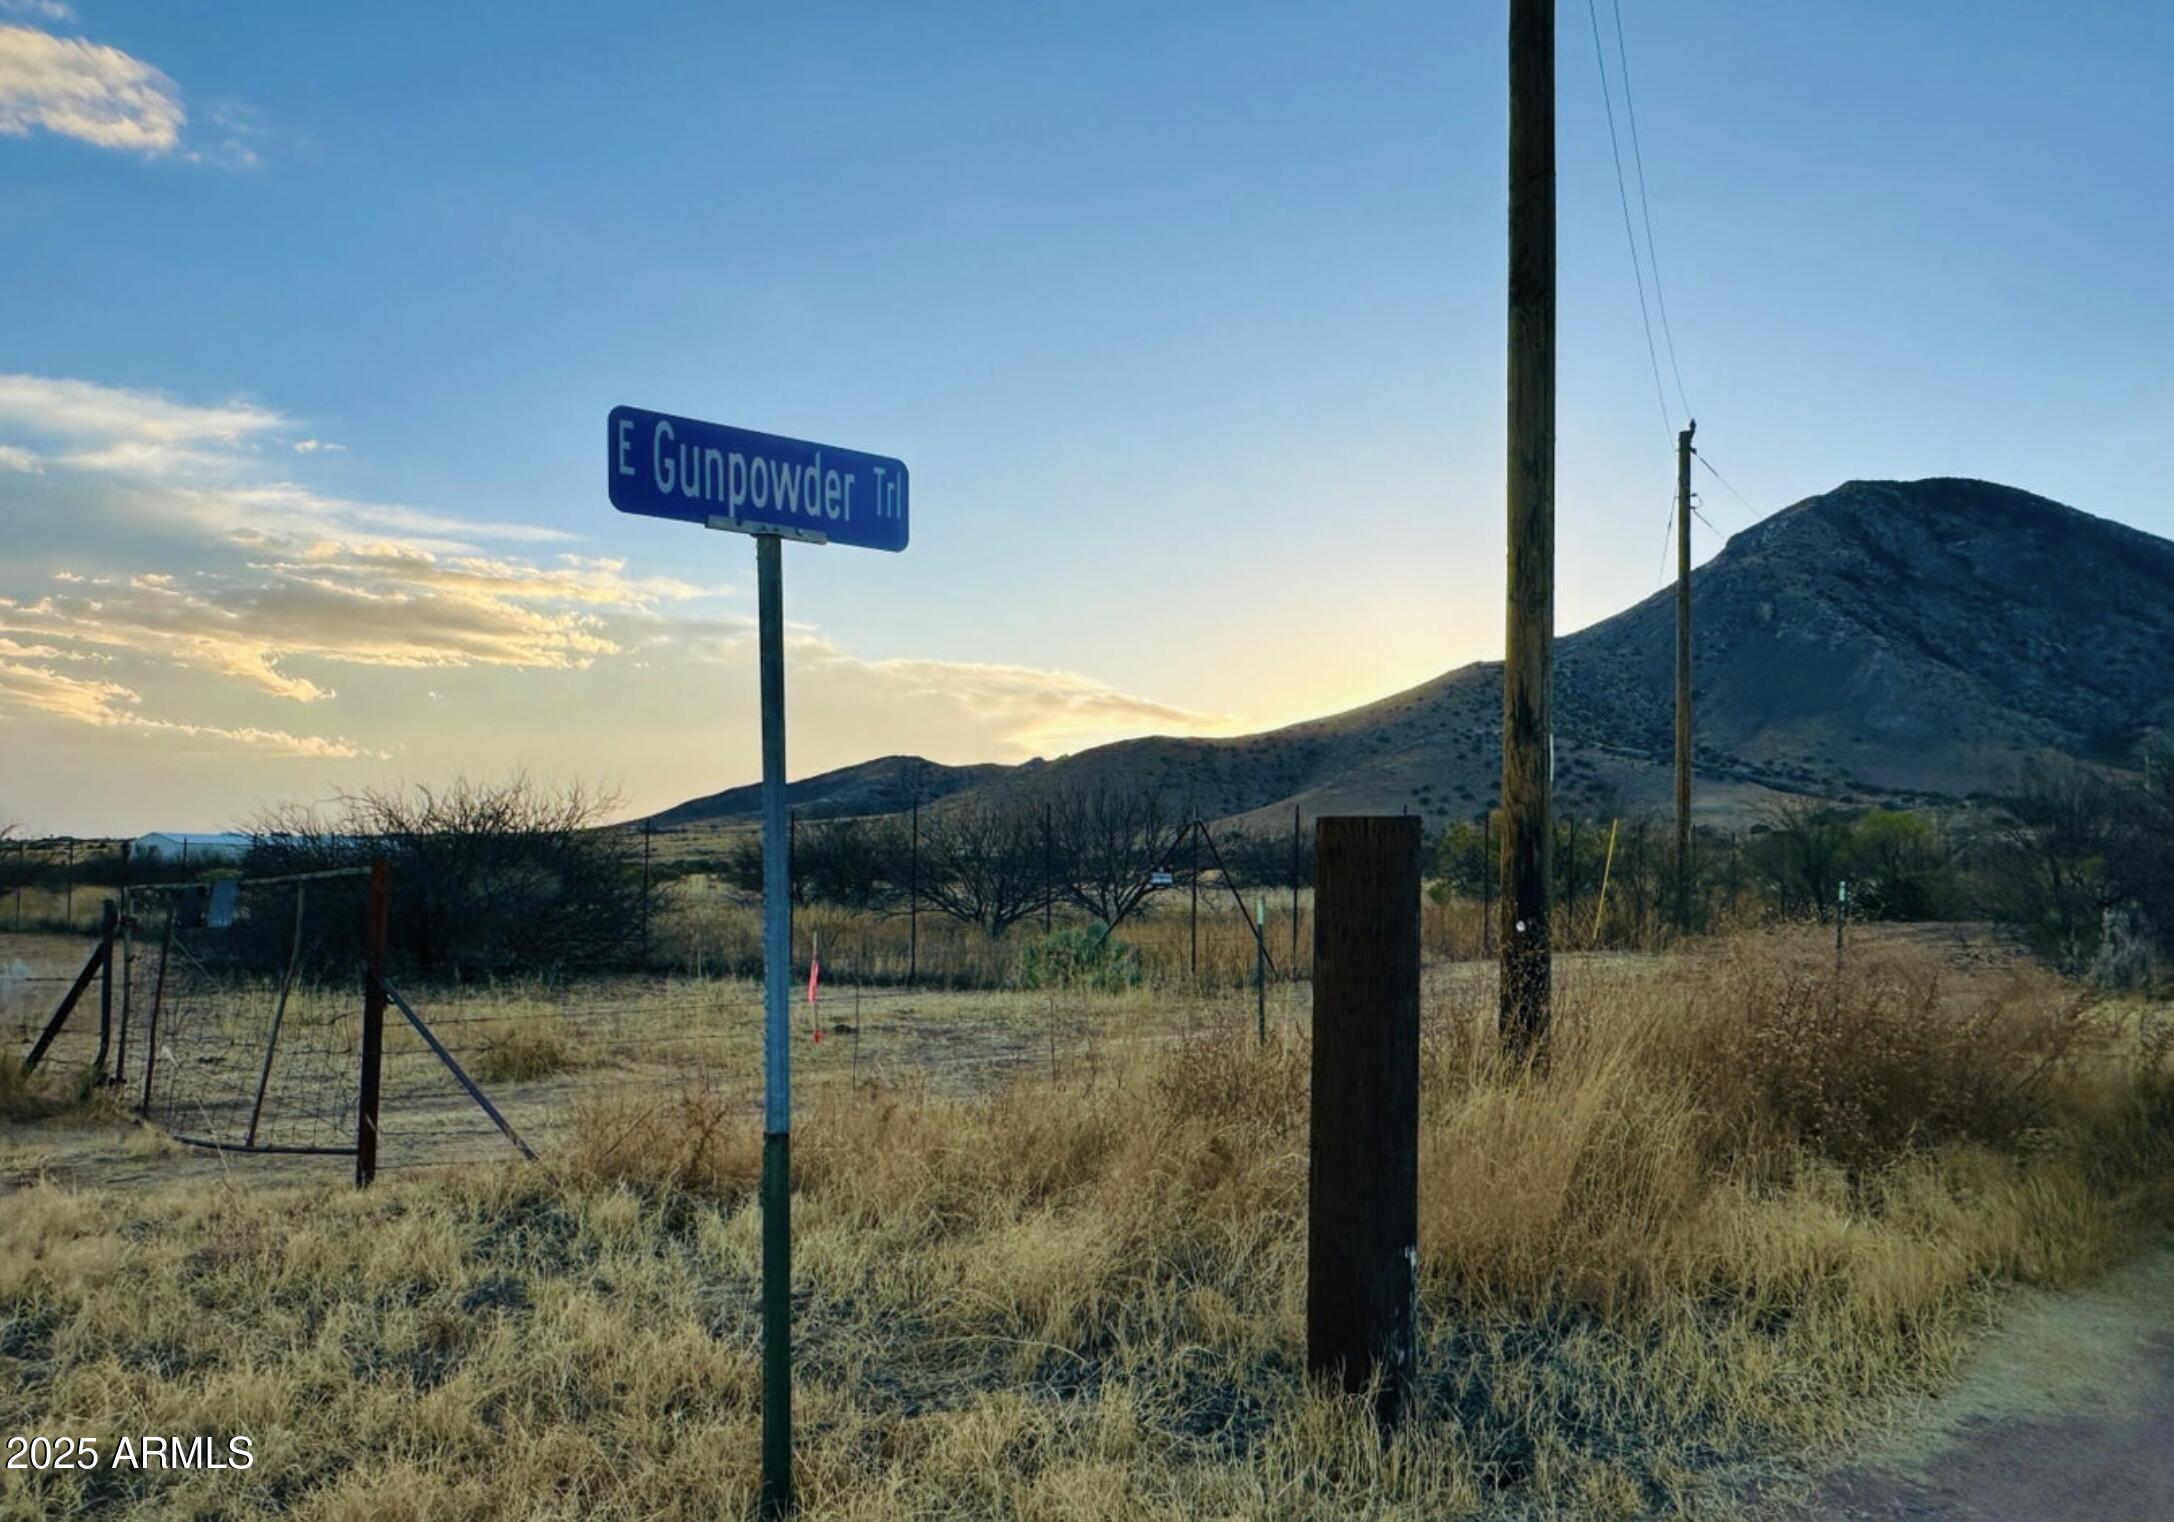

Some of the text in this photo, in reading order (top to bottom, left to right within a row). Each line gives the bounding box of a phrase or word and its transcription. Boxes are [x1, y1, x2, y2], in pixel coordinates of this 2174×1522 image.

[618, 419, 901, 522] E Gunpowder Trl
